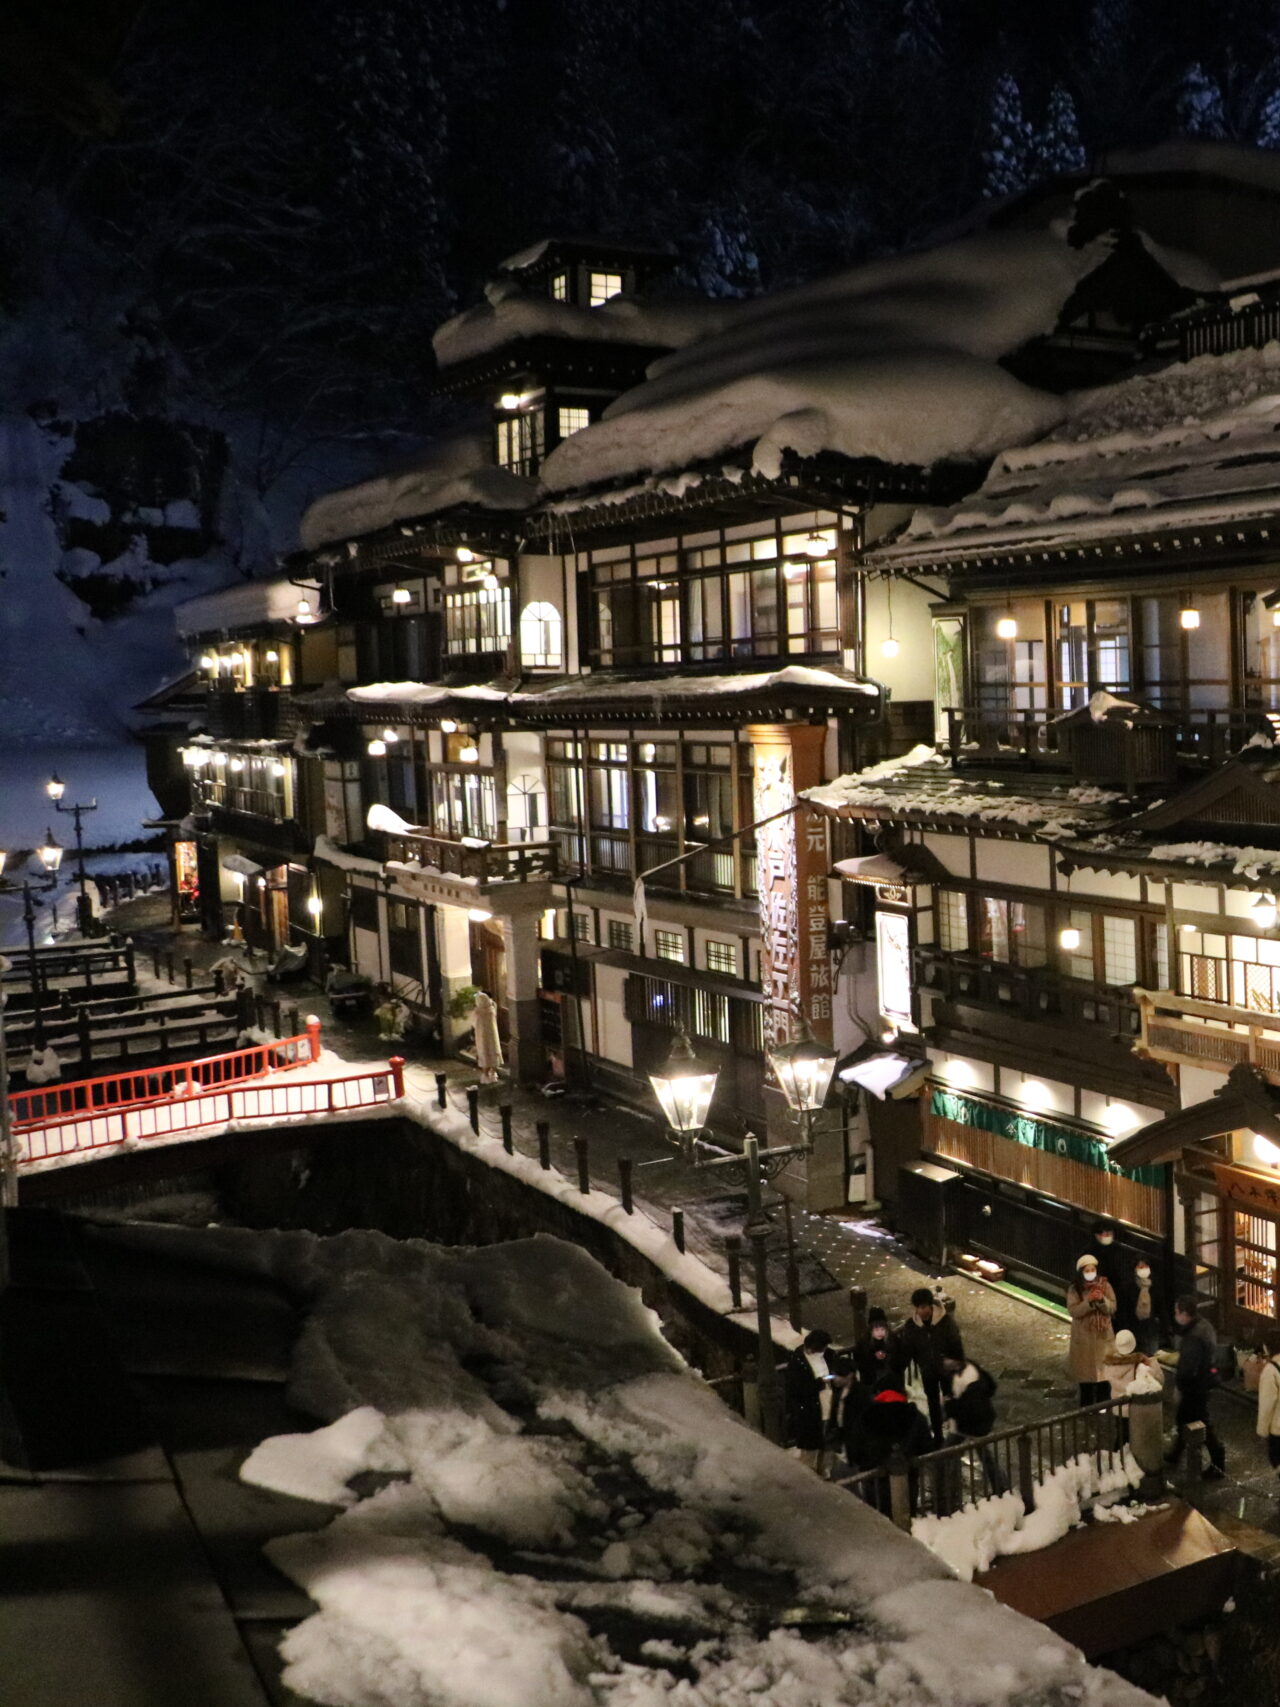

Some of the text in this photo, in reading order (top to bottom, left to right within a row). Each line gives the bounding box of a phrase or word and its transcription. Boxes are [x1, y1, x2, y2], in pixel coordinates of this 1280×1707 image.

[806, 875, 830, 1020] 能登屋旅館
